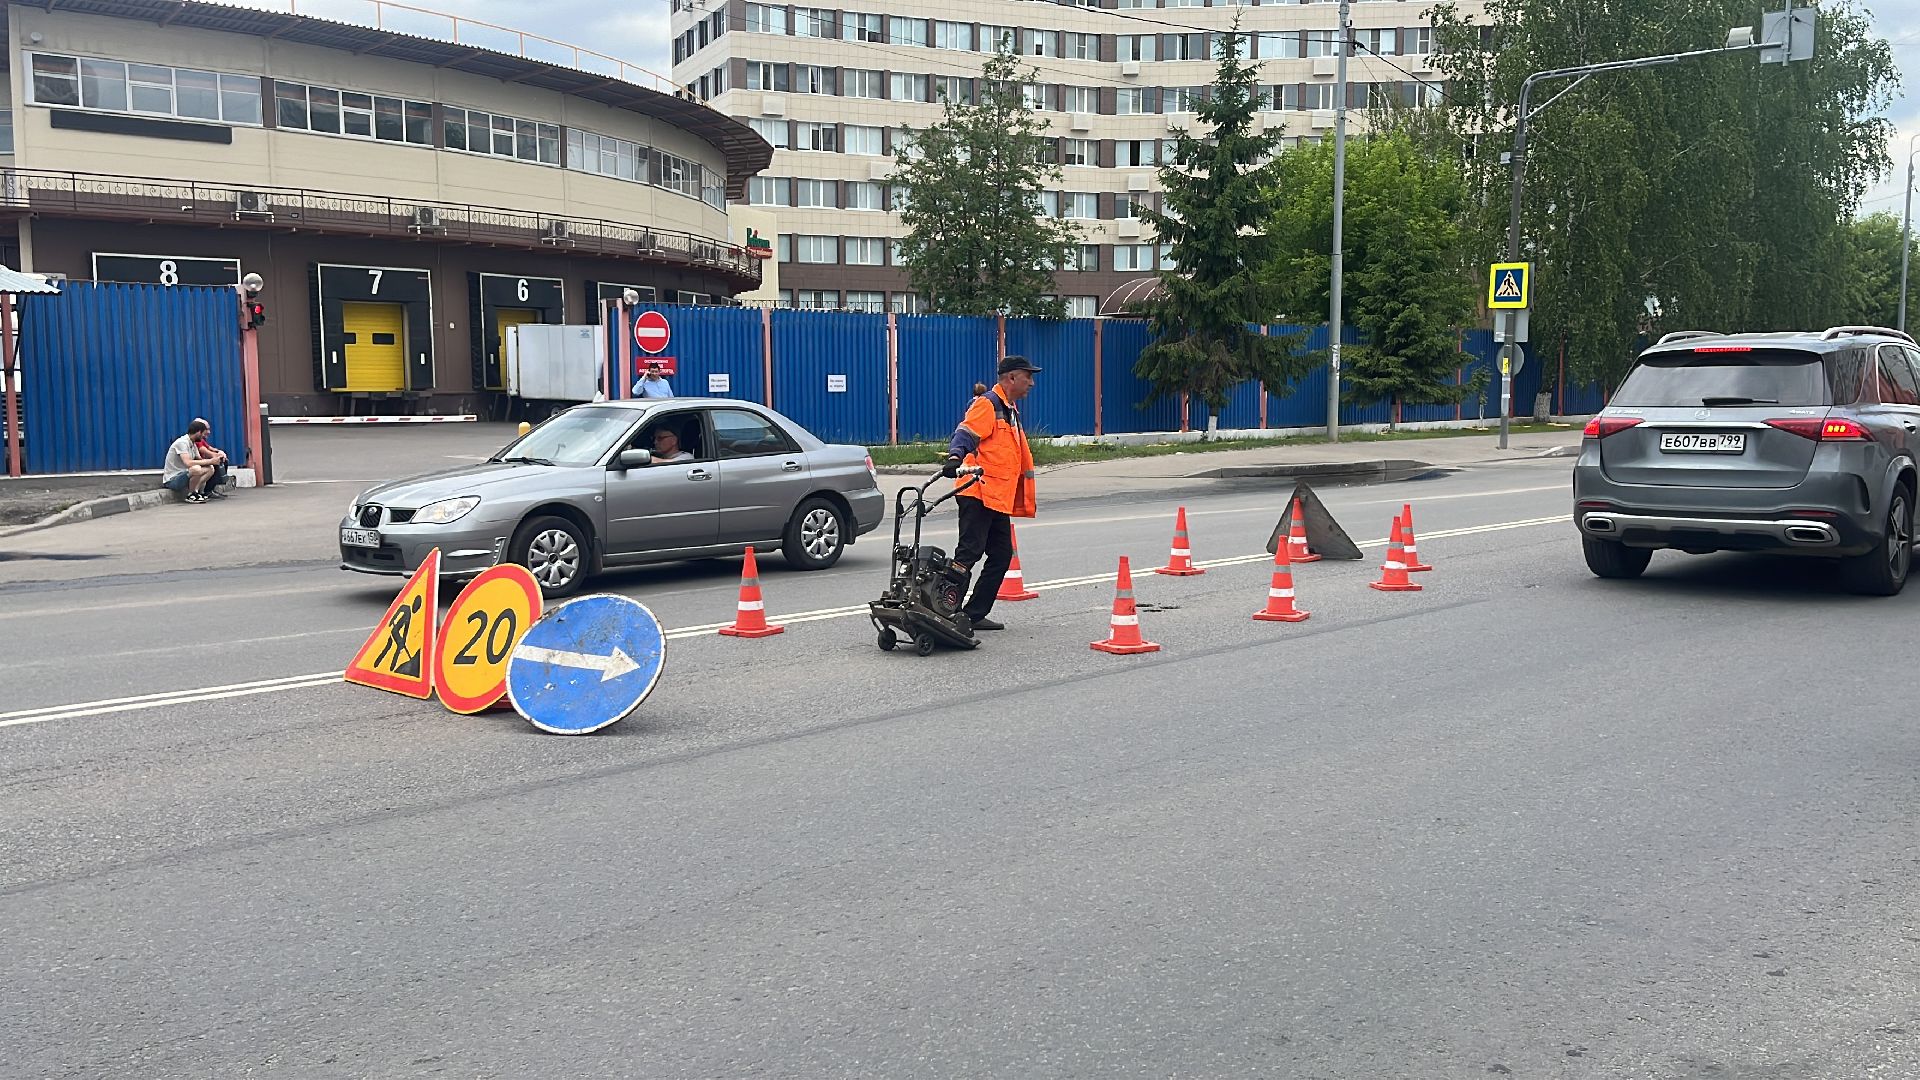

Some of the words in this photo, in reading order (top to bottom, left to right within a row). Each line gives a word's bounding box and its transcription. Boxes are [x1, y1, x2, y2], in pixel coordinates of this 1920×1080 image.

[160, 260, 178, 286] 8
[369, 270, 382, 294] 7
[518, 279, 528, 301] 6
[1720, 434, 1741, 445] 799
[453, 608, 516, 665] 20
